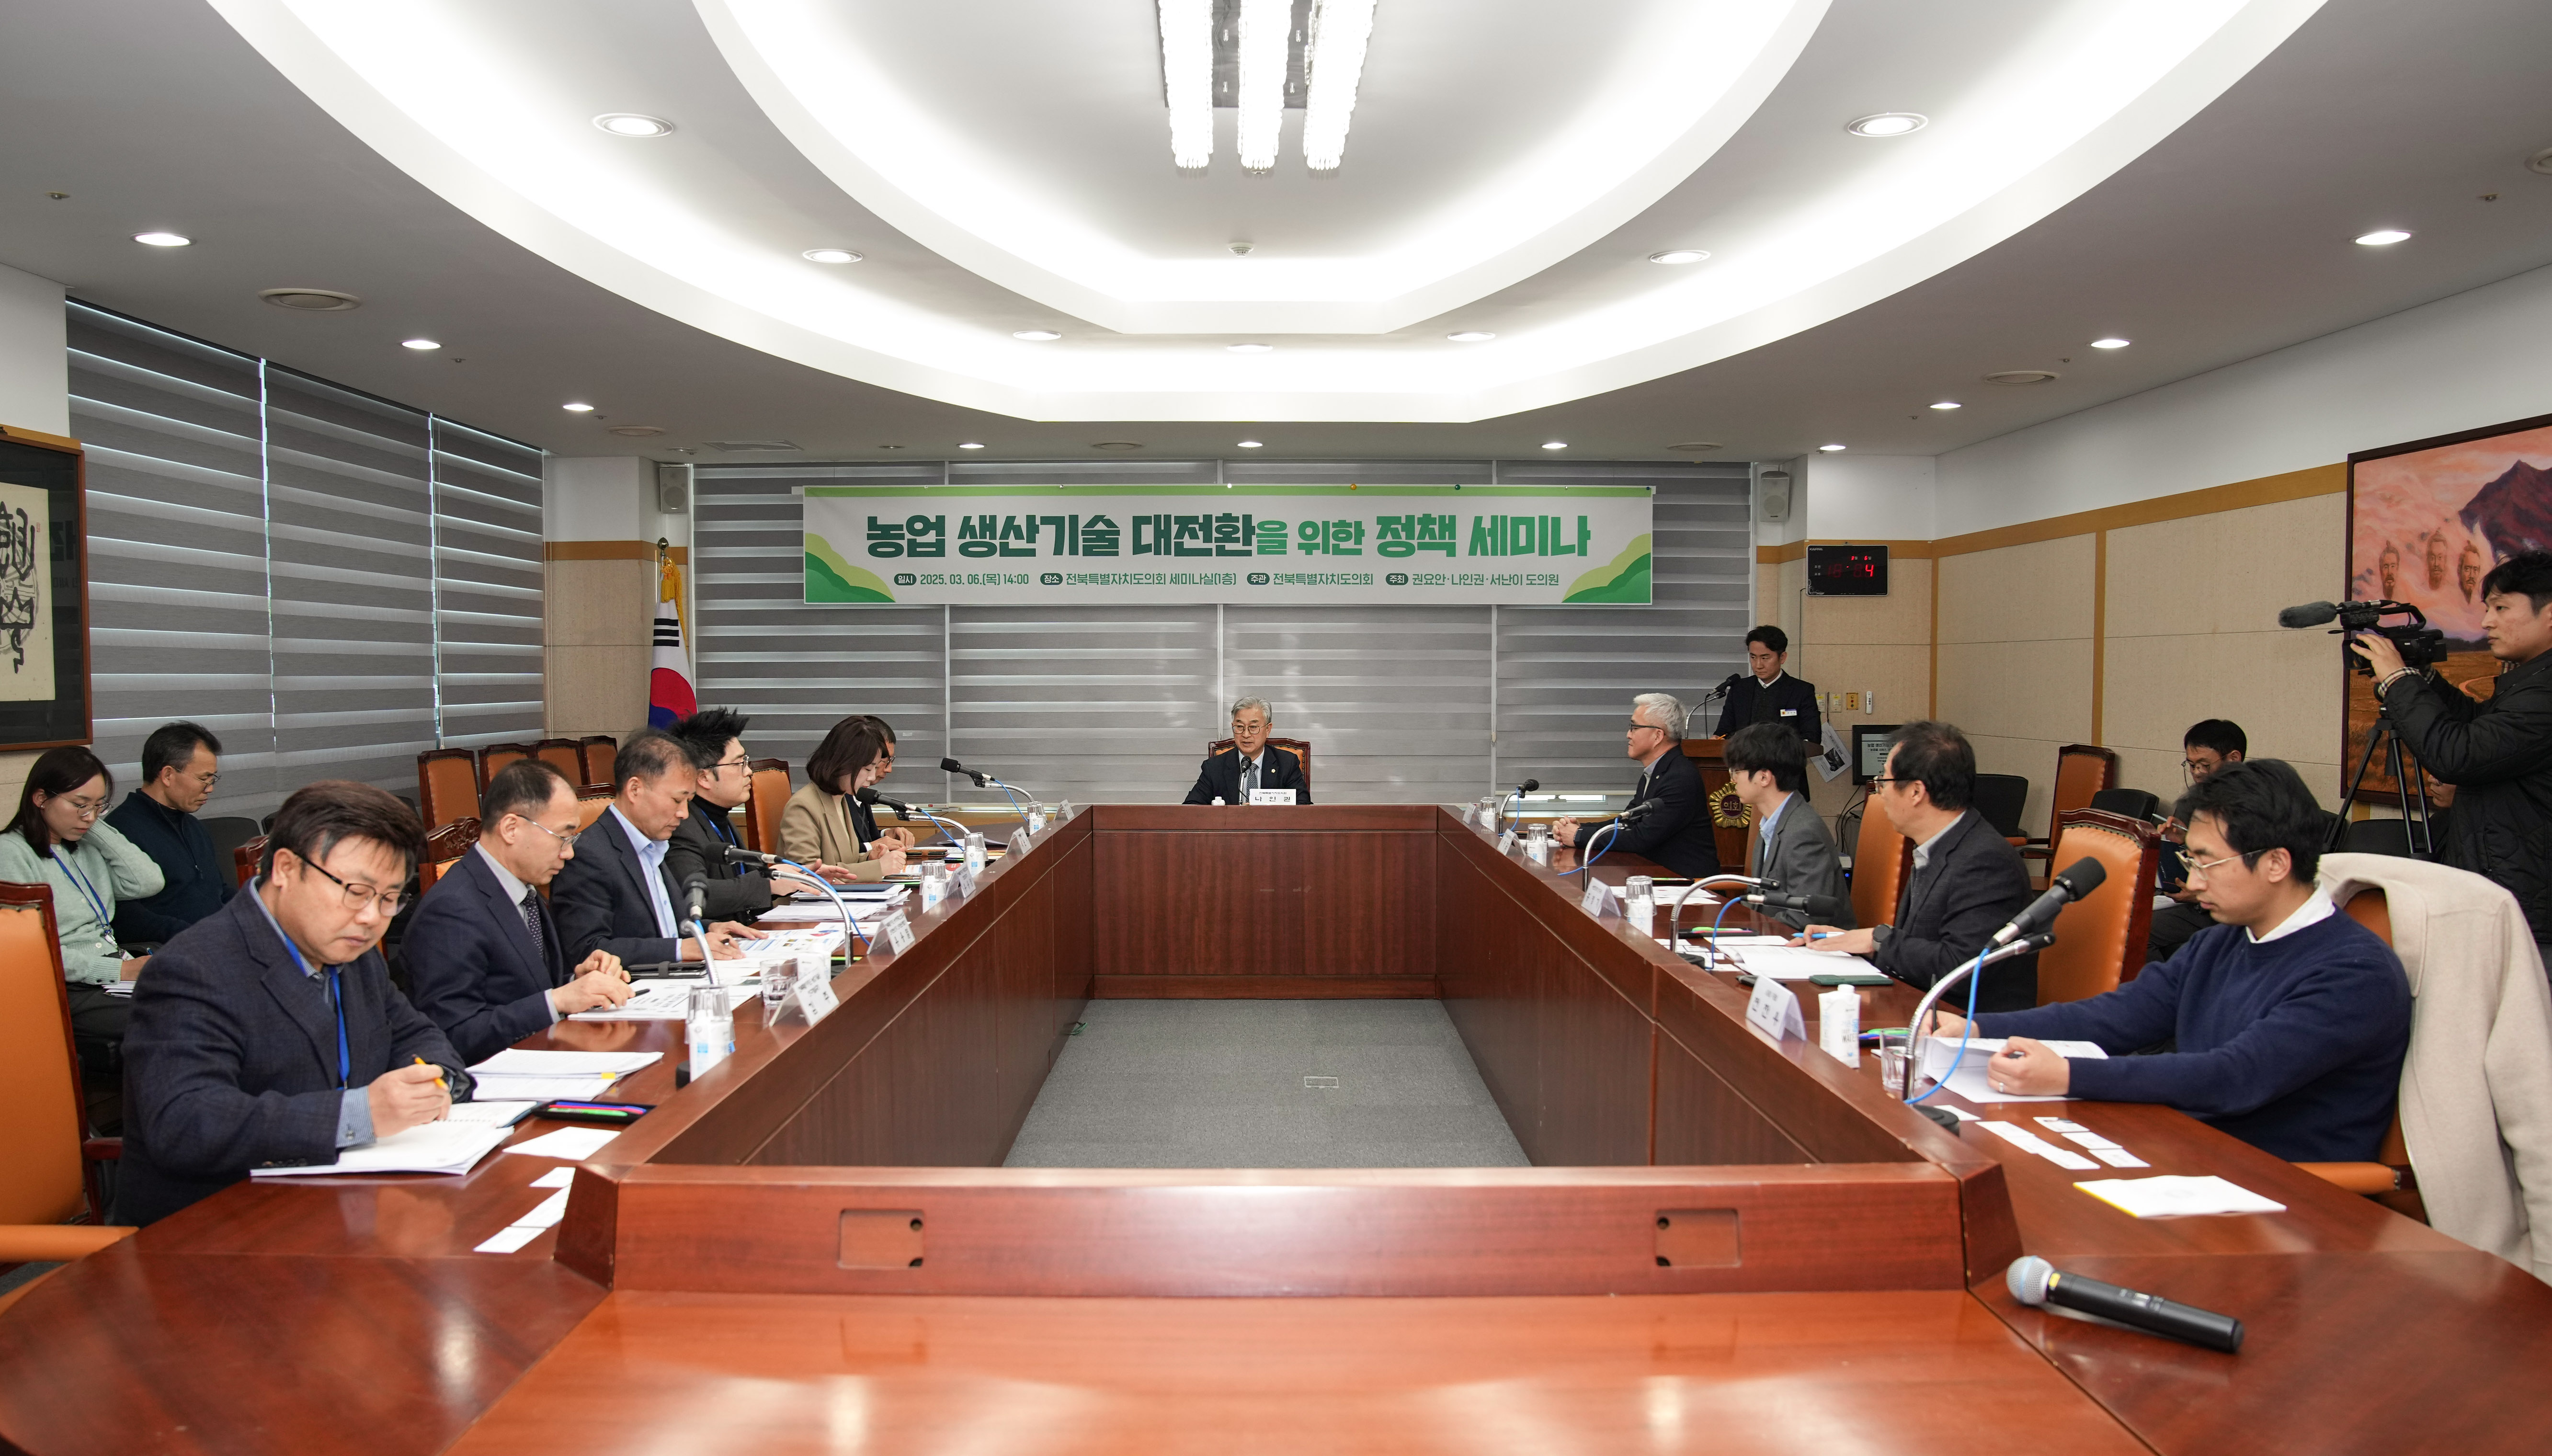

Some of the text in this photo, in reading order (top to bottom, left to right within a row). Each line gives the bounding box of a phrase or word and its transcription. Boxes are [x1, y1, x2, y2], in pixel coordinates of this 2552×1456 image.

[866, 513, 1591, 558] 농업 생산기술 대전환을 위한 정책 세미나
[921, 574, 946, 585] 2025.
[950, 574, 964, 584] 03.
[1003, 574, 1028, 584] 14:00
[1066, 573, 1236, 585] 전북특별자치도의회 세미나실(1층)
[1251, 575, 1266, 583] 주관
[1274, 573, 1373, 585] 전북특별자치도의회
[1390, 575, 1404, 583] 주최
[1526, 574, 1559, 585] 도의원
[1722, 801, 1742, 811] 의회
[1842, 1034, 1858, 1043] WATE
